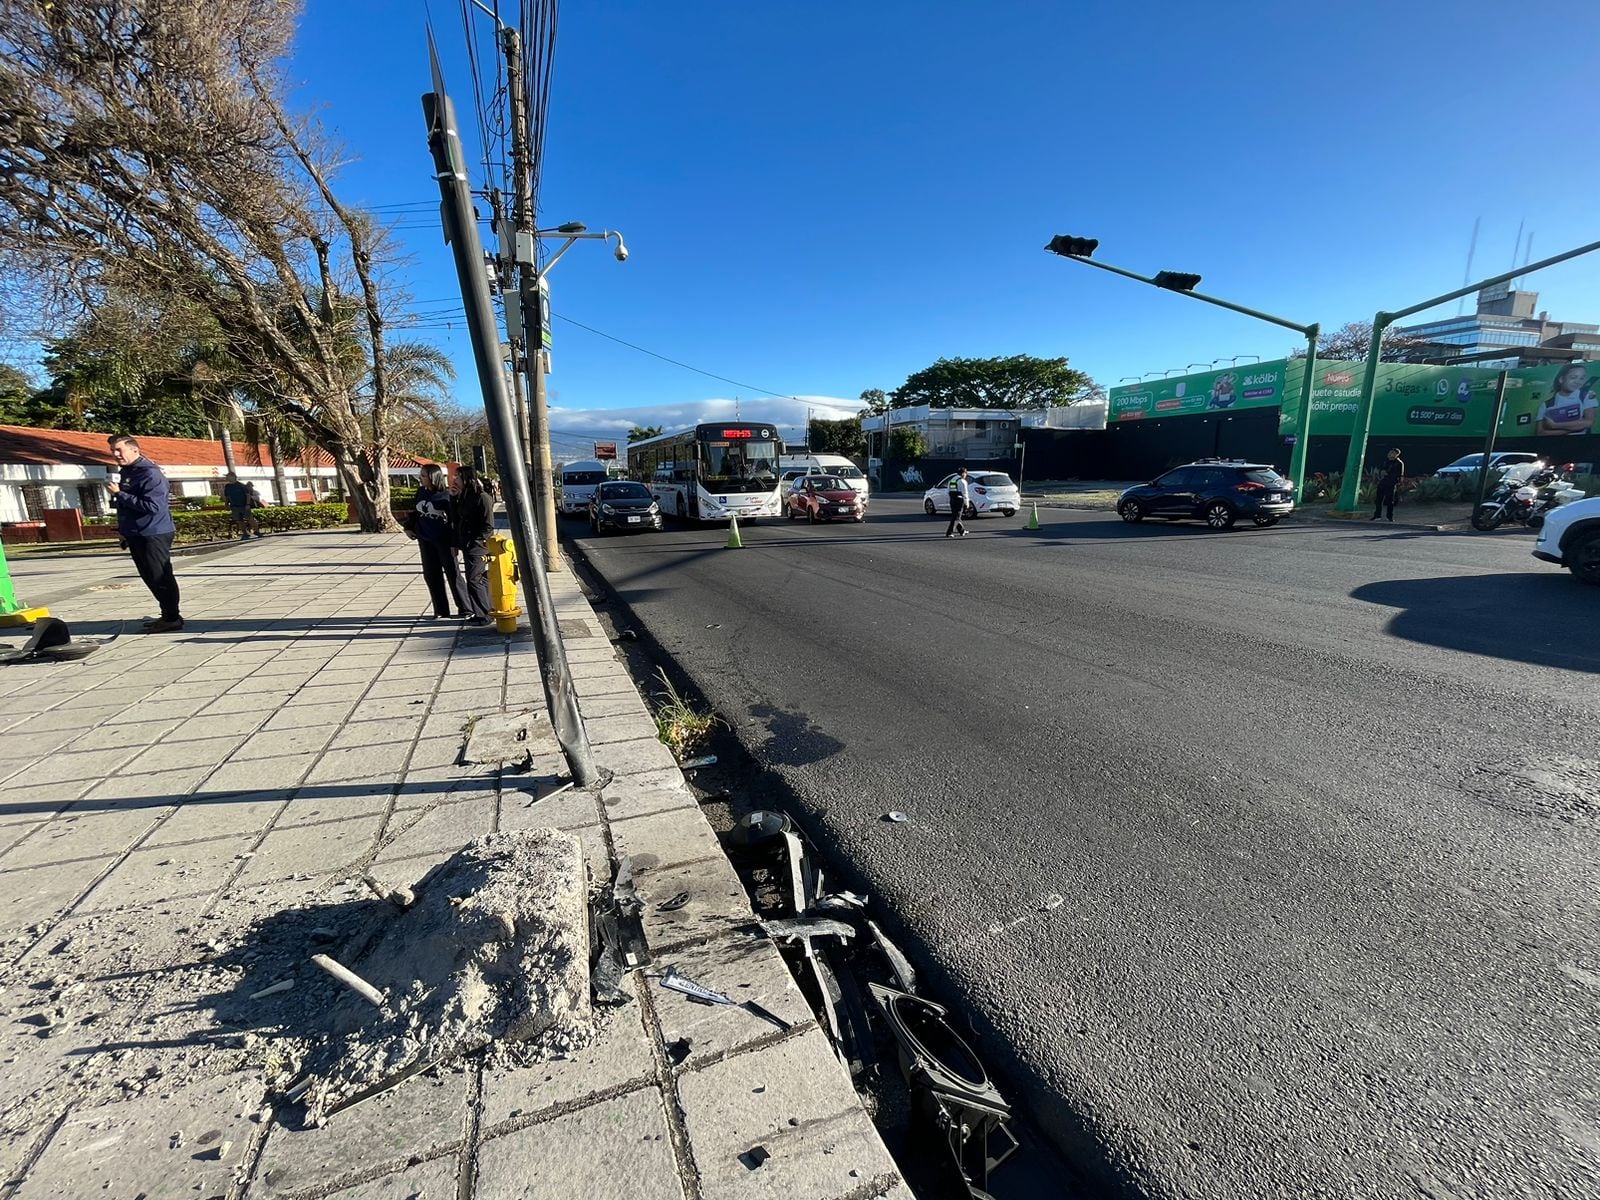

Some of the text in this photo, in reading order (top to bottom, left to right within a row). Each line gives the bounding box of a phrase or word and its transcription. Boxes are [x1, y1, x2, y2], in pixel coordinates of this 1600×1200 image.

[1253, 372, 1278, 385] kölbi
[1385, 378, 1393, 392] 3
[1395, 381, 1420, 396] Gigas
[1116, 397, 1129, 407] 200
[1129, 395, 1148, 405] Mbps
[1330, 403, 1359, 412] prepag
